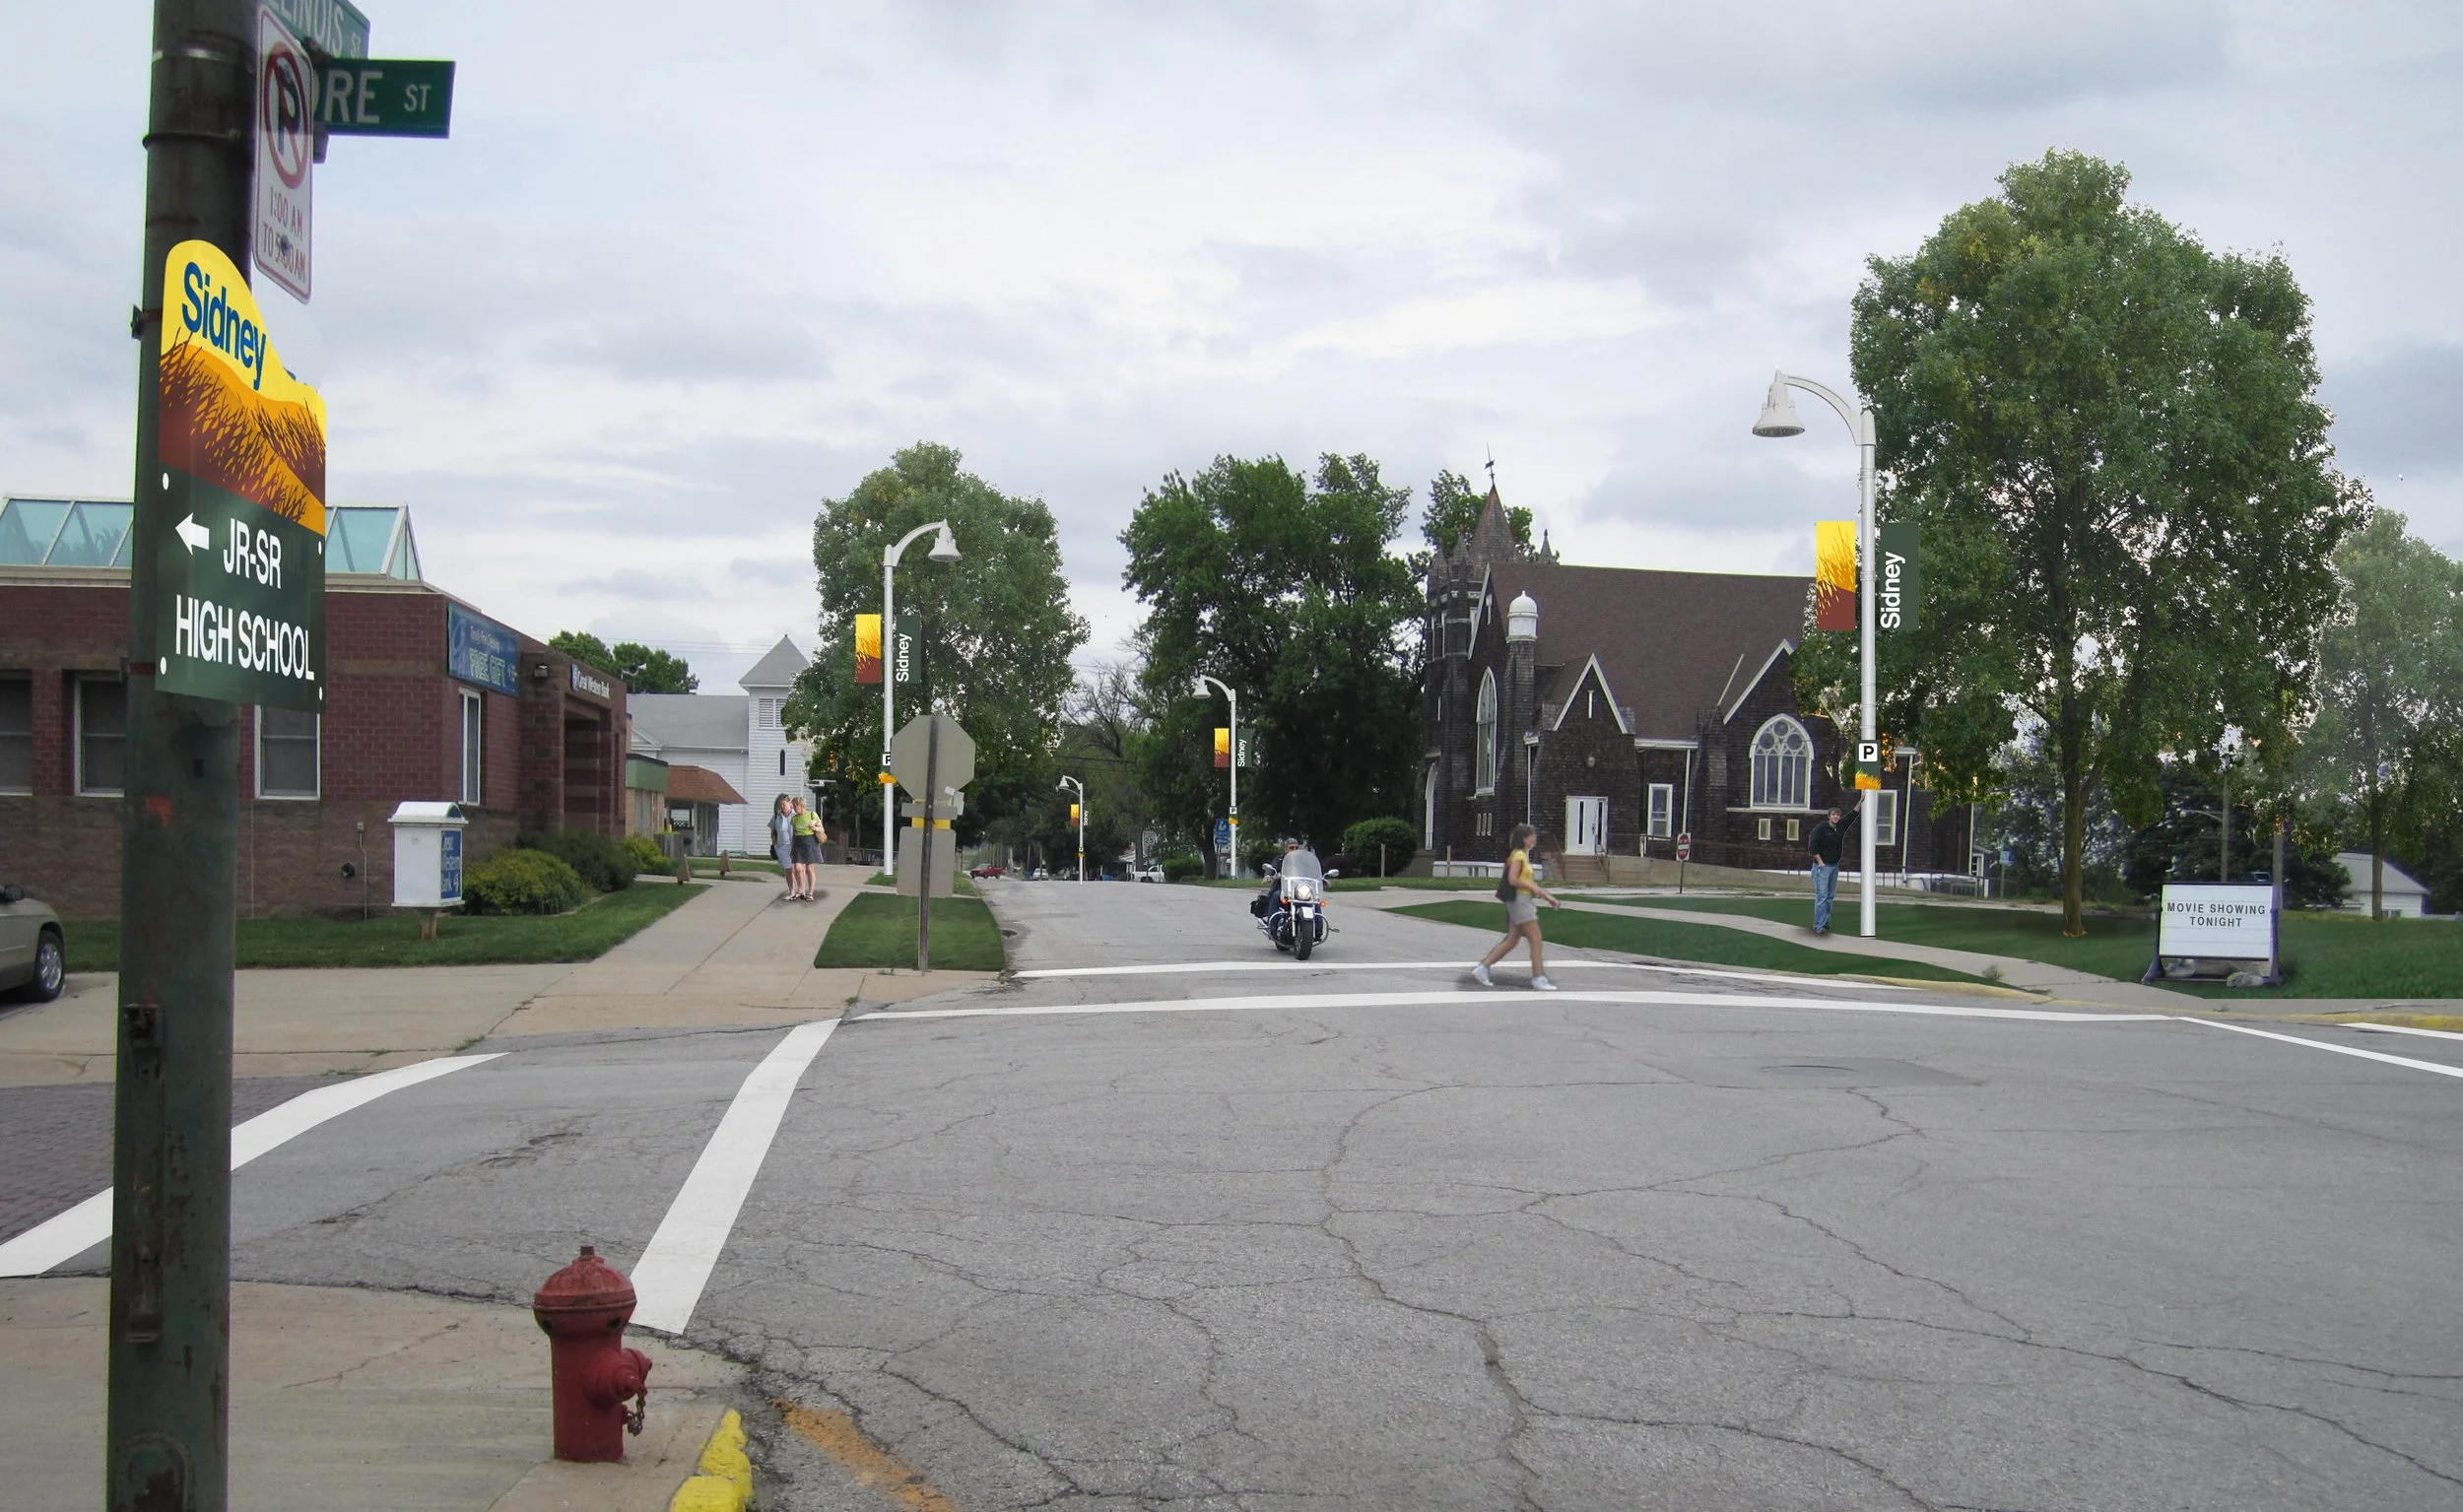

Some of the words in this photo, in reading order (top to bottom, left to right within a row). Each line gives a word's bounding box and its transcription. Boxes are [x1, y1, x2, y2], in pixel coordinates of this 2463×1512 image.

[312, 68, 383, 124] RE
[404, 84, 433, 112] ST
[270, 186, 289, 228] 1:00
[291, 205, 303, 241] AM
[263, 221, 274, 257] TO
[295, 248, 305, 283] AM
[182, 262, 267, 391] Sidney
[223, 517, 282, 590] JR-SR
[1880, 551, 1906, 629] Sidney
[175, 594, 233, 665] HIGH
[237, 610, 315, 681] SCHOOL
[896, 633, 913, 683] Sidney
[1236, 739, 1247, 767] Sidney
[1863, 745, 1875, 759] P
[2166, 902, 2204, 914] MOVIE
[2210, 903, 2266, 915] SHOWING
[2189, 916, 2242, 928] TONIGHT
